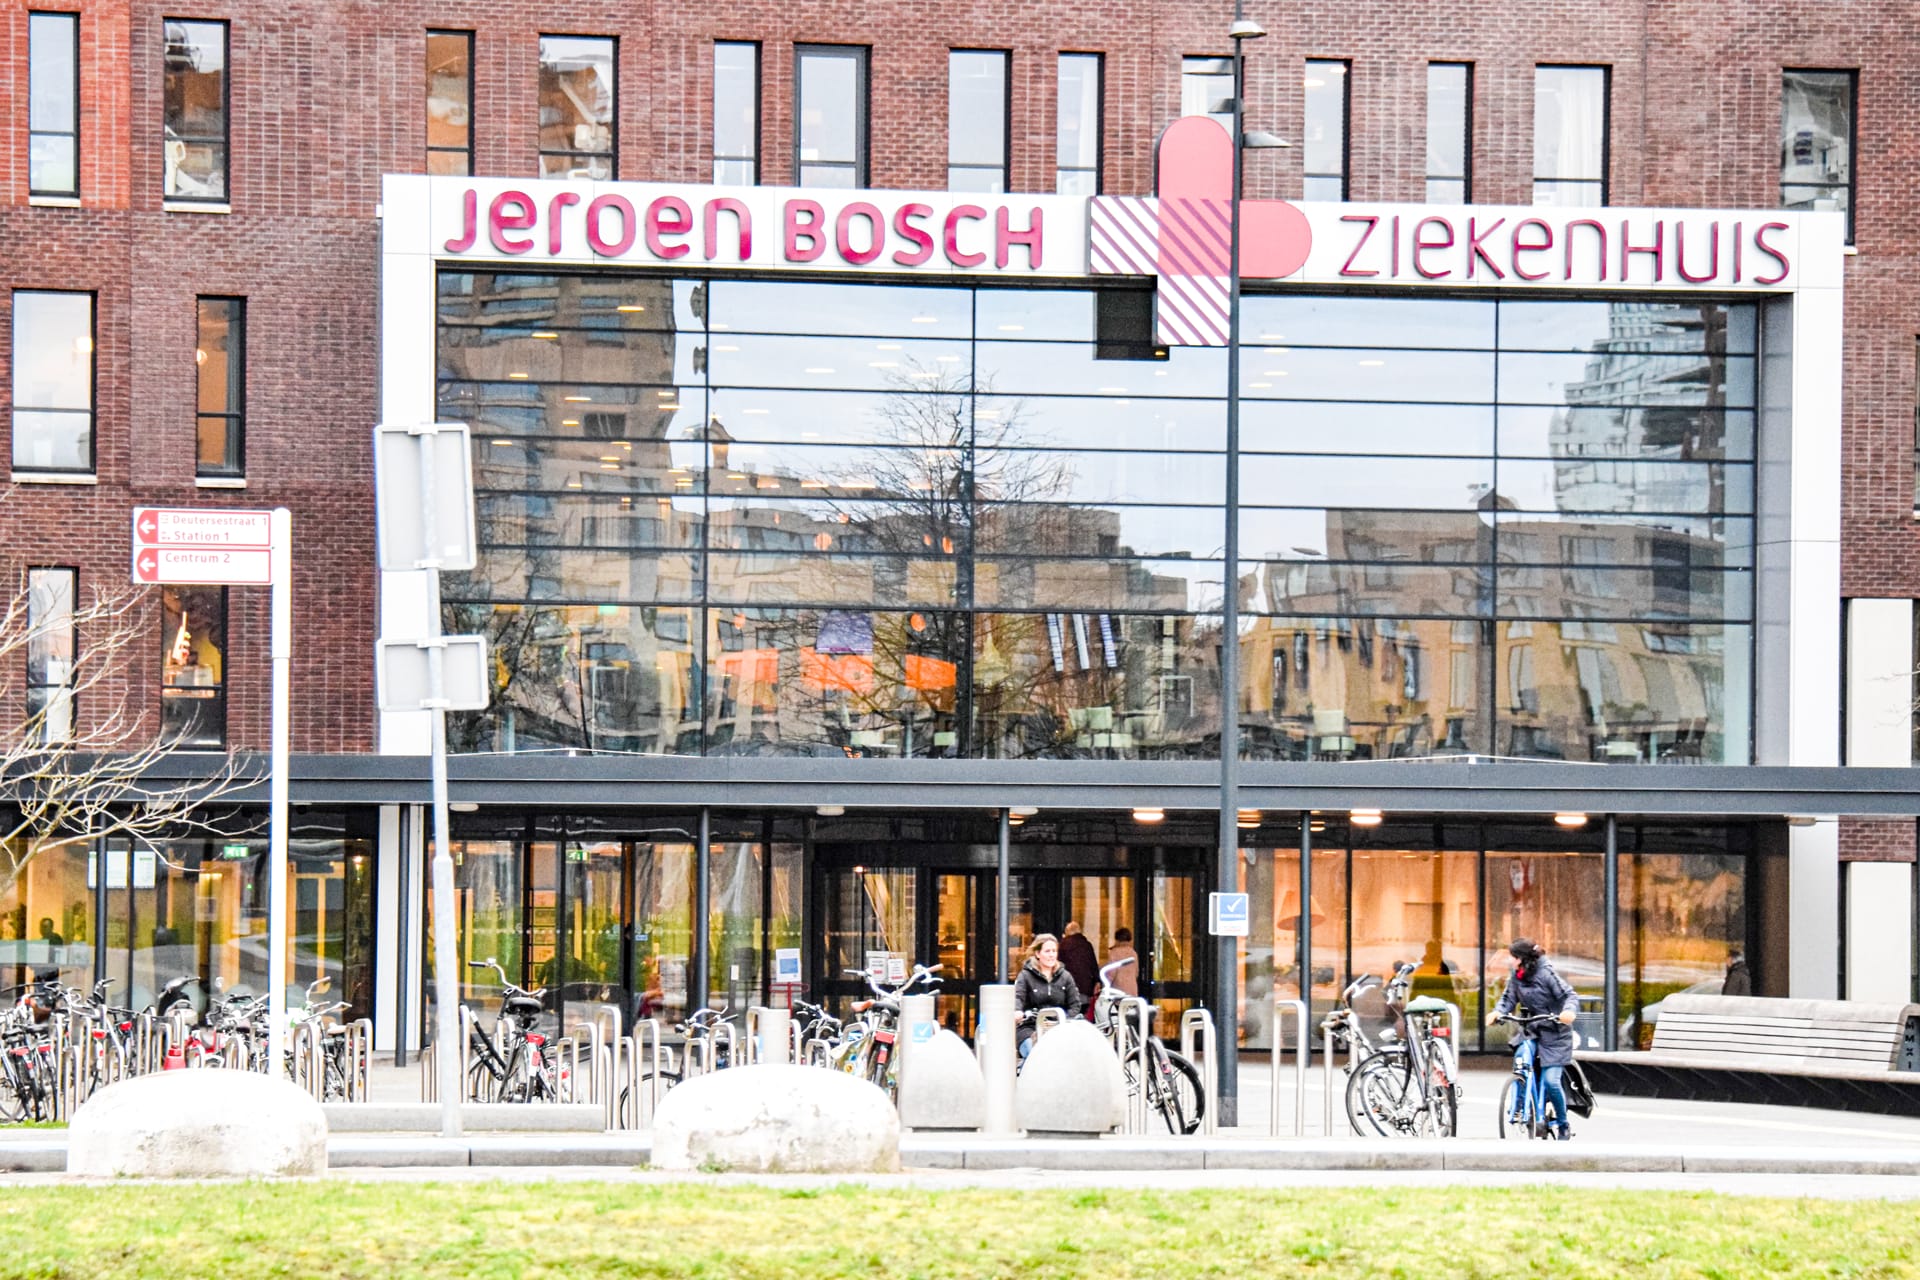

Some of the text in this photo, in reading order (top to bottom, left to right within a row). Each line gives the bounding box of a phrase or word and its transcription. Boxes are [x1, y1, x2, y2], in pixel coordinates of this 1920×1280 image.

[784, 199, 1044, 270] BOSCH
[172, 514, 267, 526] Deutersestraat 1
[174, 530, 230, 542] Station 1
[165, 552, 231, 564] Centrum 2
